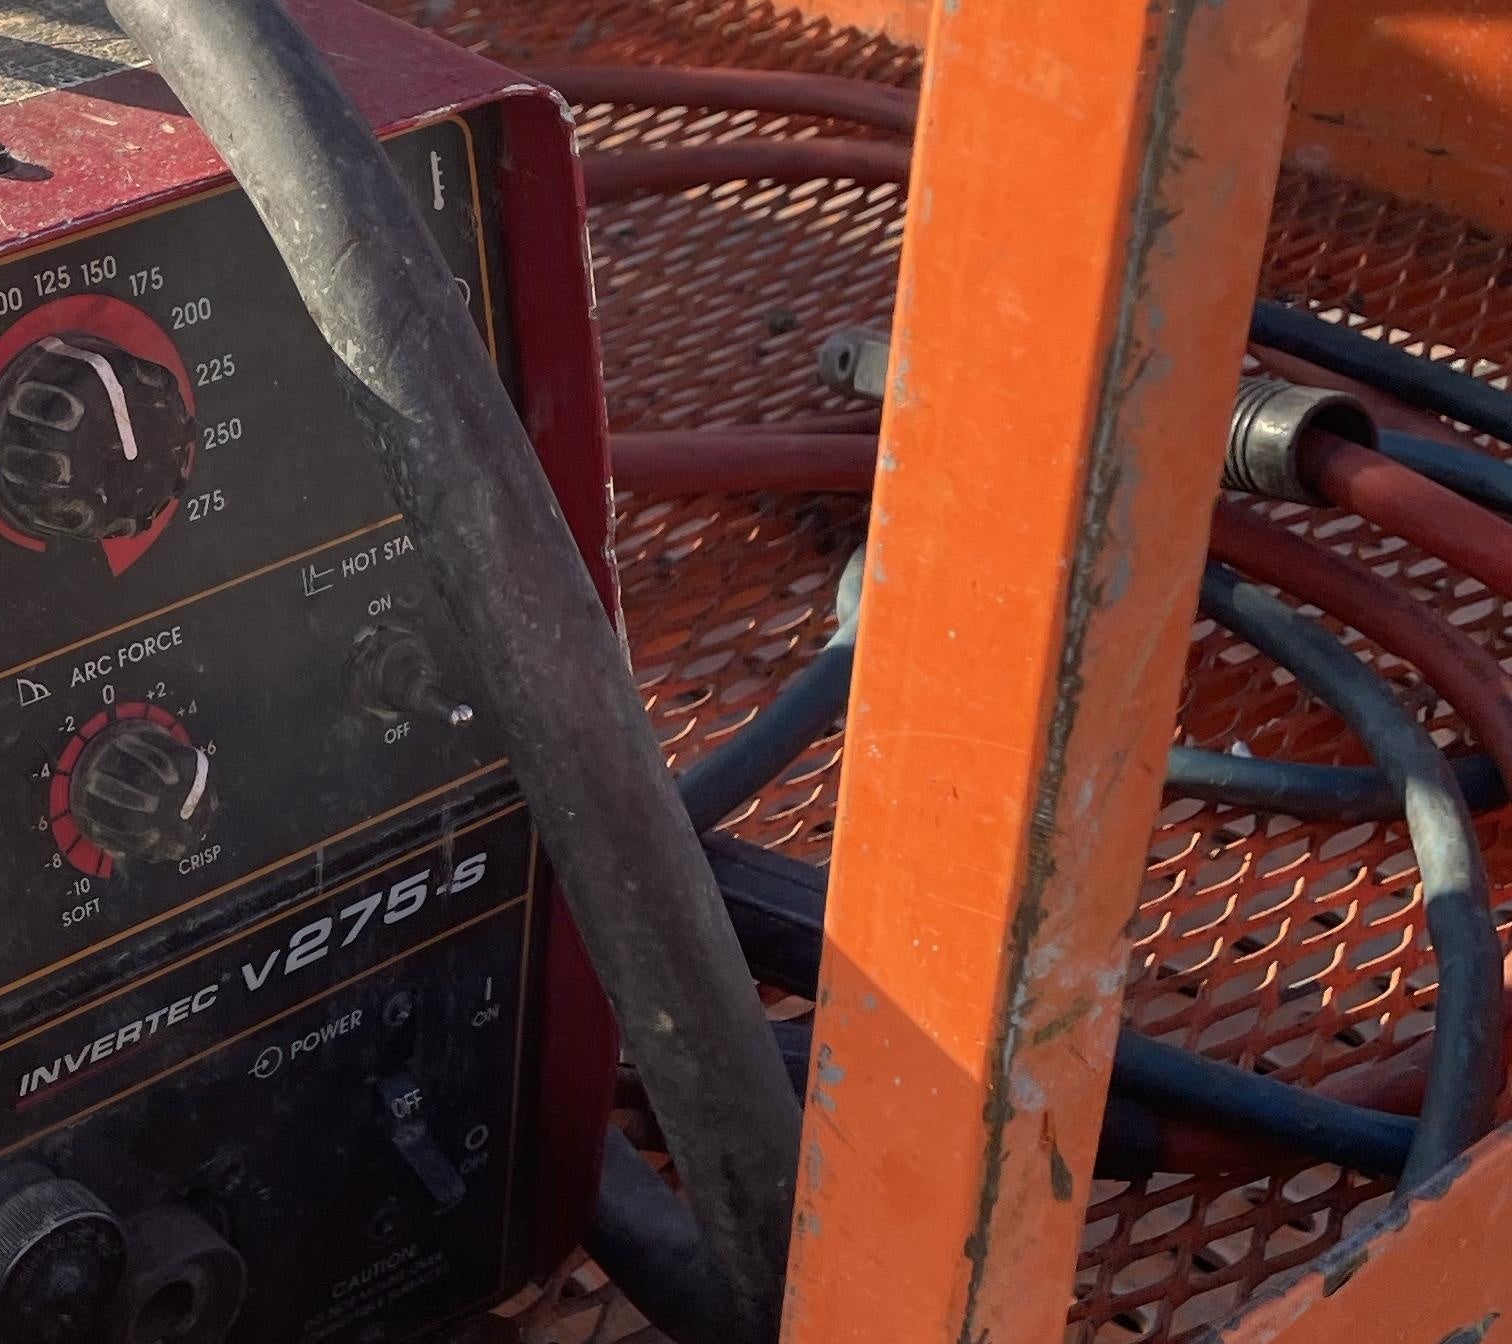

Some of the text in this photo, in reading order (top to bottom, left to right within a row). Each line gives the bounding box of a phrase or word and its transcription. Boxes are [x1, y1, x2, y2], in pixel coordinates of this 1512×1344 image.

[34, 265, 71, 297] 125
[80, 255, 117, 287] 150
[129, 266, 164, 297] 175
[172, 297, 212, 330] 200
[196, 354, 235, 387] 225
[204, 417, 242, 450] 250
[187, 489, 226, 522] 275
[341, 534, 415, 577] HOT STA
[367, 594, 392, 616] ON
[70, 626, 184, 688] ARC FORCE
[101, 684, 116, 704] 0
[146, 682, 167, 700] +2
[58, 716, 76, 733] -2
[176, 701, 198, 718] +4
[384, 721, 411, 744] OFF
[32, 762, 51, 780] -4
[44, 852, 63, 869] -8
[178, 843, 223, 875] CRISP
[66, 877, 91, 896] -10
[61, 898, 102, 928] SOFT
[471, 1004, 501, 1027] ON
[19, 984, 220, 1098] INVERTEC
[290, 1009, 363, 1059] POWER
[390, 1088, 423, 1119] OFF
